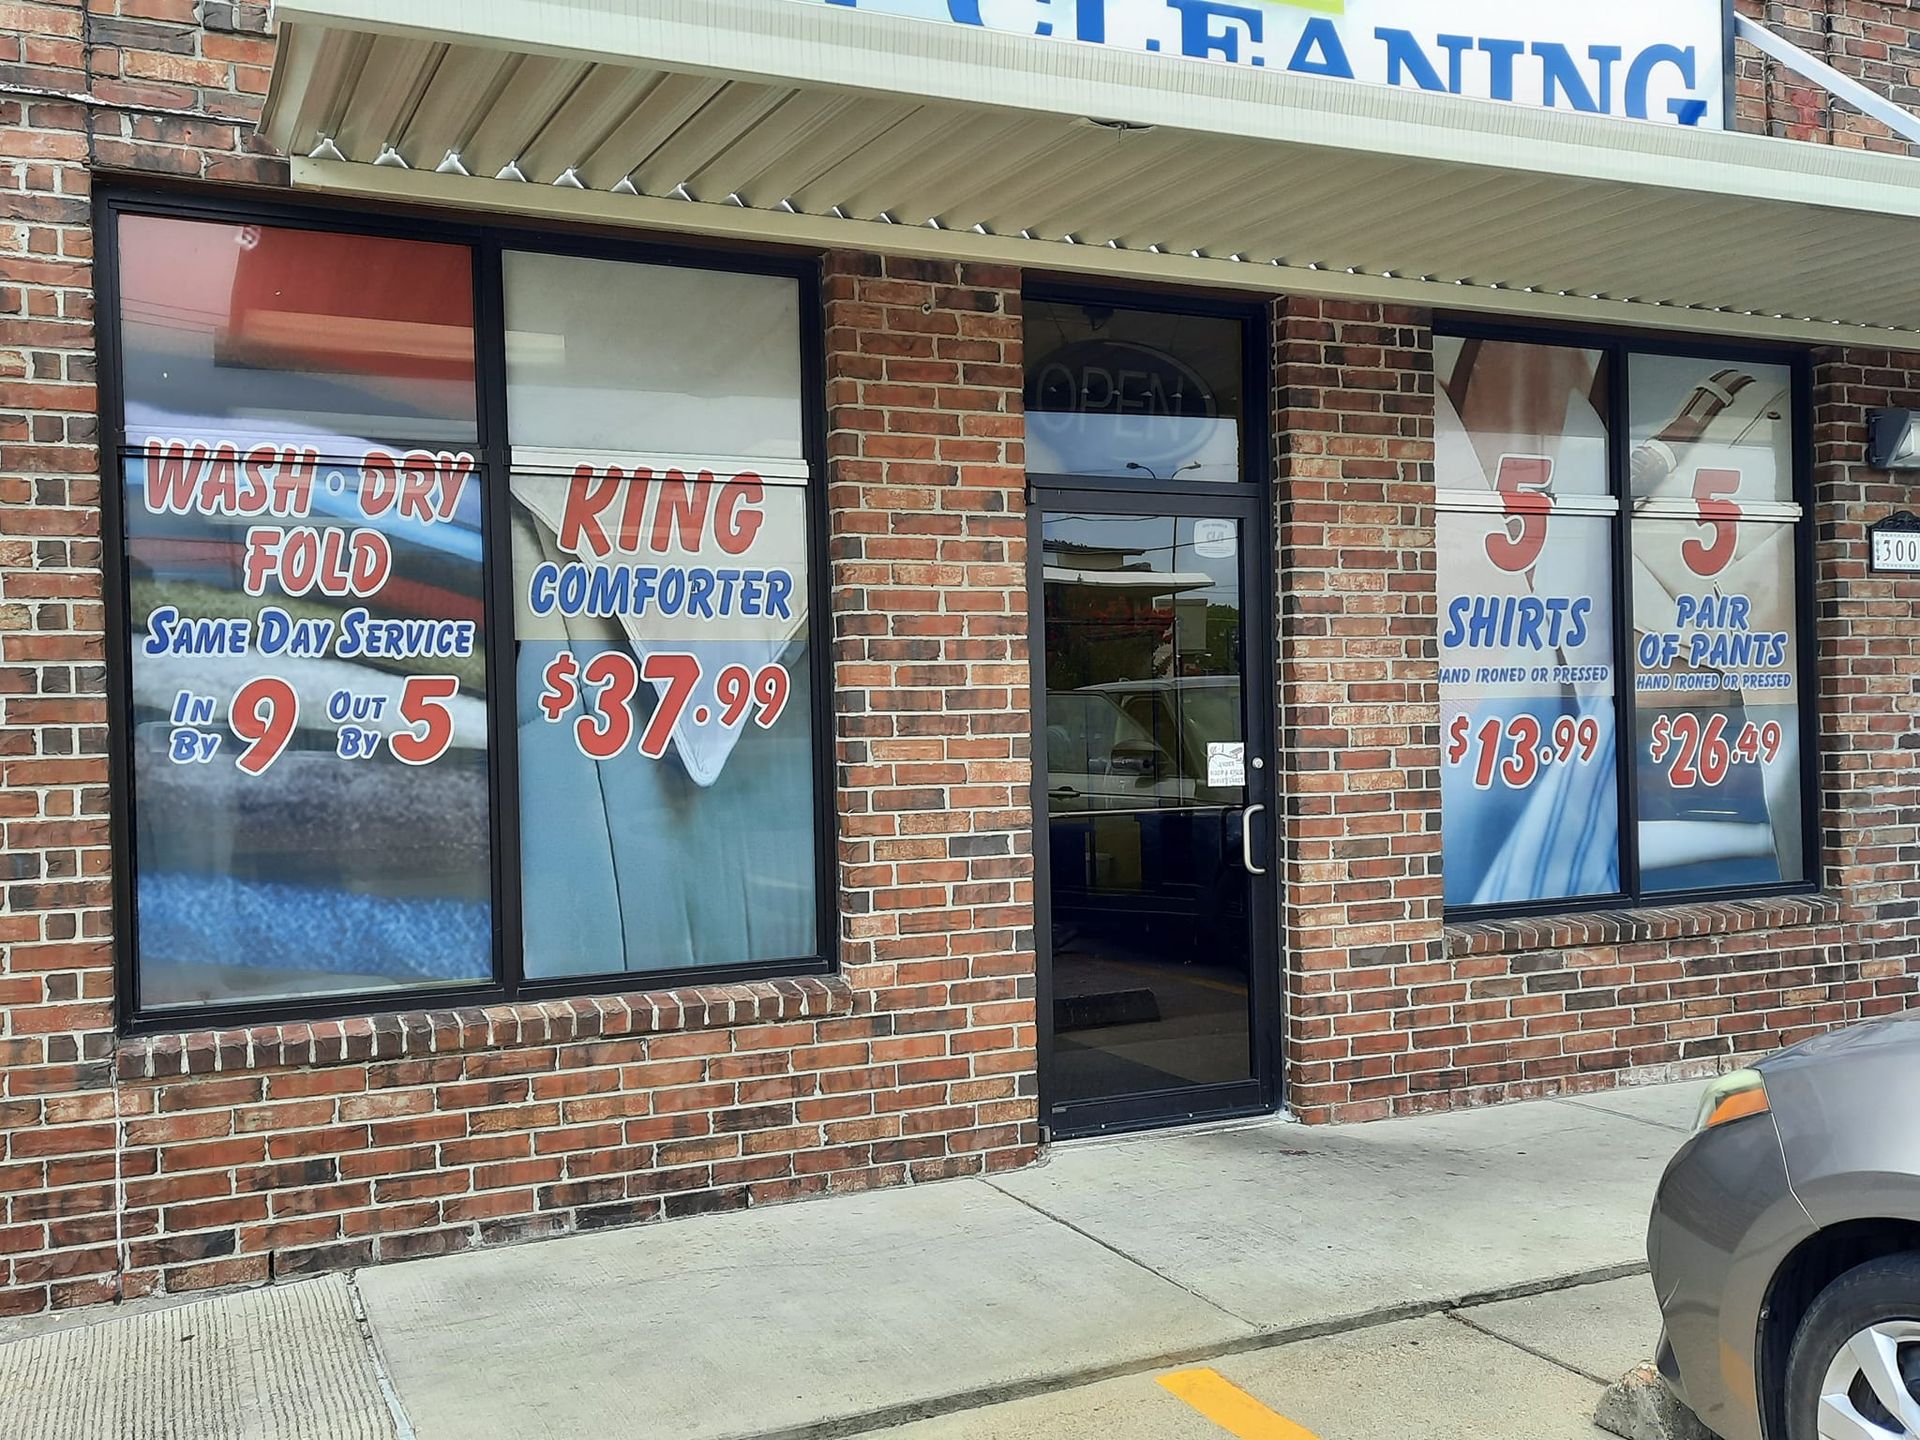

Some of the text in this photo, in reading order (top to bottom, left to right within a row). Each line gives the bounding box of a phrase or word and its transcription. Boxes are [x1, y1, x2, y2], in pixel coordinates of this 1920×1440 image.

[1036, 361, 1185, 441] OPEN
[146, 439, 473, 523] WASH DRY
[560, 464, 765, 557] KING
[1485, 456, 1553, 573] 5
[1682, 468, 1742, 576] 5
[247, 529, 391, 595] FOLD
[529, 564, 793, 620] COMFORTER
[145, 608, 475, 657] SAME DAY SERVICE
[1443, 596, 1593, 652] SHIRTS
[1676, 595, 1750, 631] PAIR
[1475, 667, 1527, 684] IRONED
[1531, 667, 1549, 683] OR
[1552, 666, 1610, 683] PRESSED
[1639, 633, 1788, 668] OF PANTS
[173, 692, 216, 724] IN
[327, 690, 388, 721] OUT
[540, 653, 789, 758] $37.99
[1636, 673, 1792, 690] HAND IRONED OR PRESSED
[171, 729, 221, 763] BY
[231, 677, 298, 774] 9
[338, 728, 381, 758] BY
[389, 677, 459, 764] 5
[1651, 713, 1783, 788] $26.49
[1448, 715, 1600, 788] $13.99
